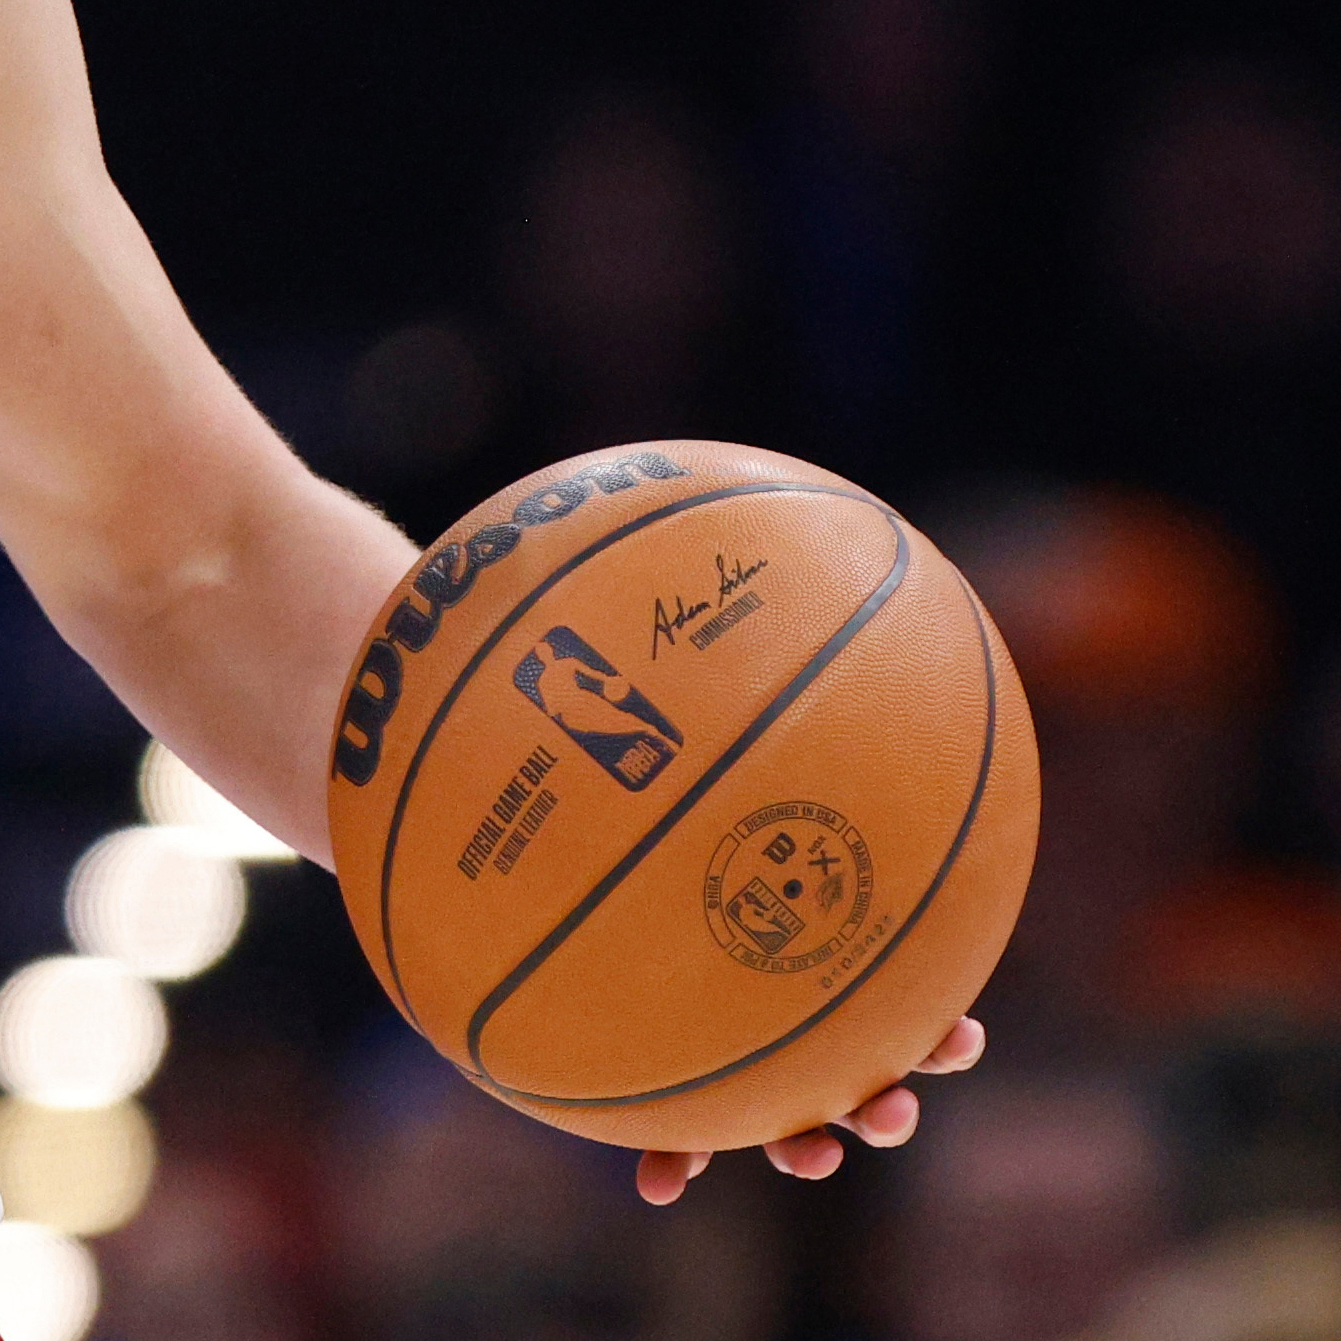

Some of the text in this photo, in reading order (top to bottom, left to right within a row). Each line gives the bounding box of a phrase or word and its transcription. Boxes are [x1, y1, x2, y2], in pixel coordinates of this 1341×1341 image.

[332, 452, 691, 787] Wilson
[688, 591, 765, 651] COMMISSIONER
[614, 740, 661, 783] NBA
[457, 745, 559, 881] OFFICIAL GAME BALL
[493, 789, 558, 875] GENUINE LEATHER
[744, 805, 838, 834] DESIGNED IN USA
[851, 839, 871, 925] MADE IN CHINA
